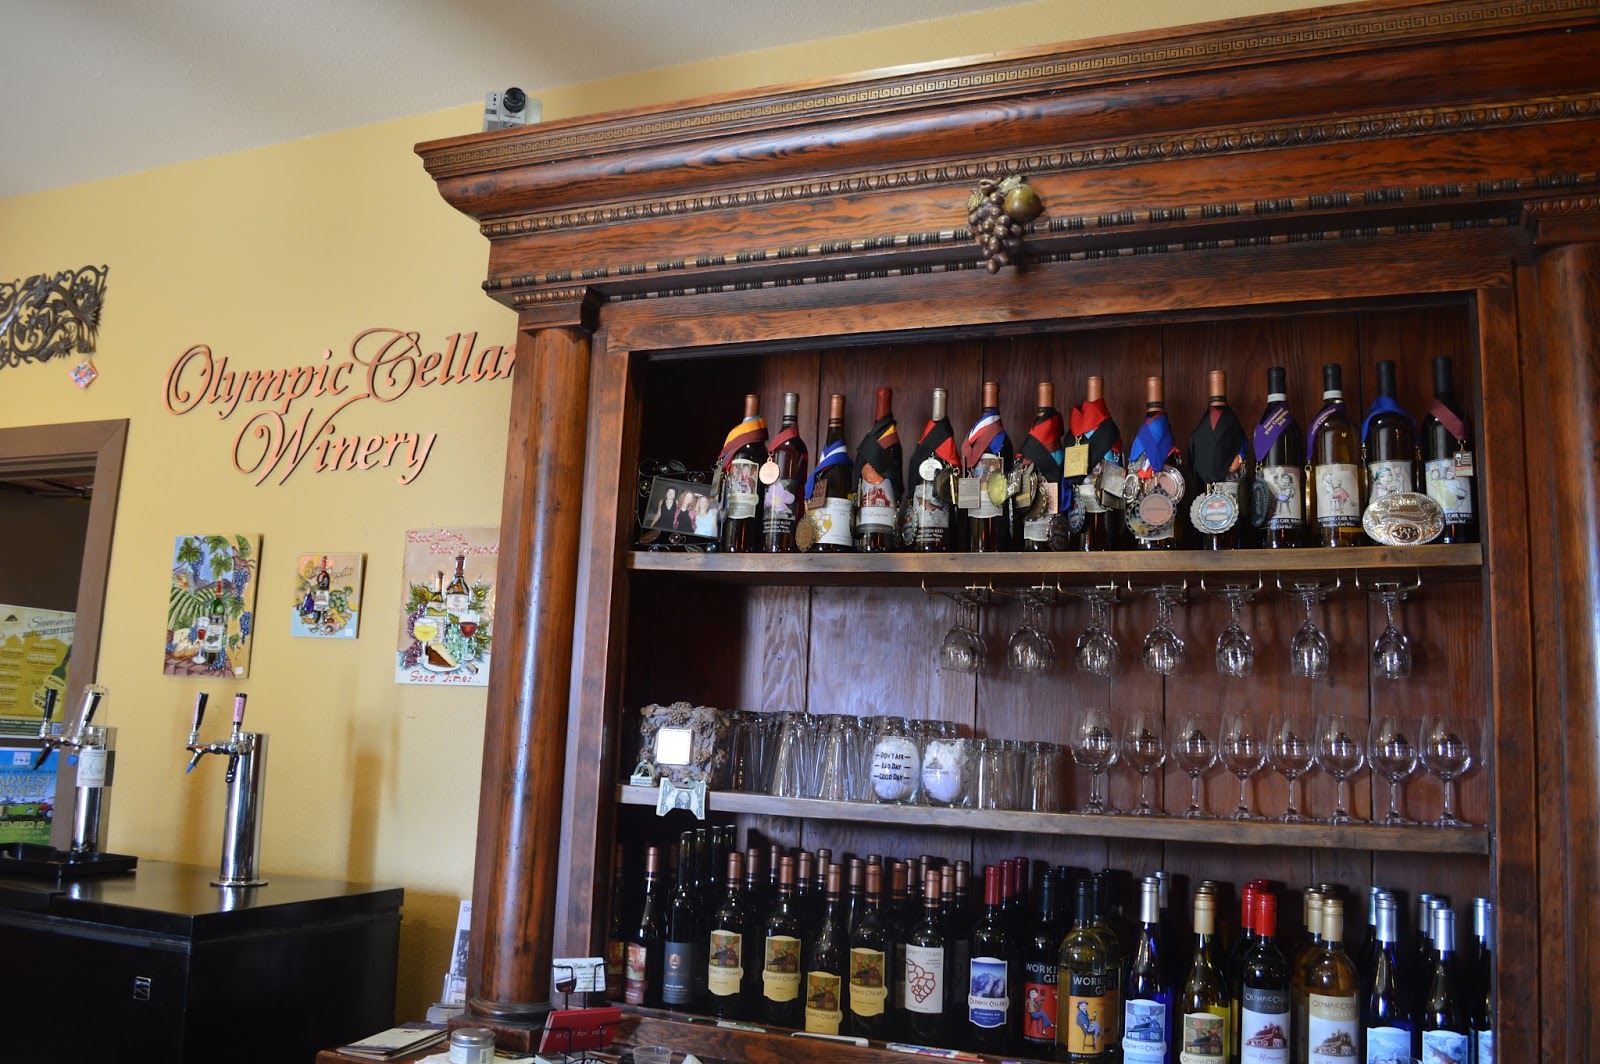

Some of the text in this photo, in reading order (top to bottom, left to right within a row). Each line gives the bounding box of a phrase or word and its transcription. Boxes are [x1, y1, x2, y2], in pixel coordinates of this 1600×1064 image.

[163, 344, 354, 420] Olympic
[232, 393, 438, 487] Winery
[35, 627, 60, 637] CONCERT
[410, 669, 437, 682] Good
[891, 763, 902, 771] DAY
[878, 772, 904, 781] GOOD DAY
[1245, 993, 1272, 1003] OLYMPIC
[1312, 999, 1340, 1010] OLYMPIC
[577, 1029, 589, 1037] for
[1123, 1041, 1144, 1051] OLYMPIC
